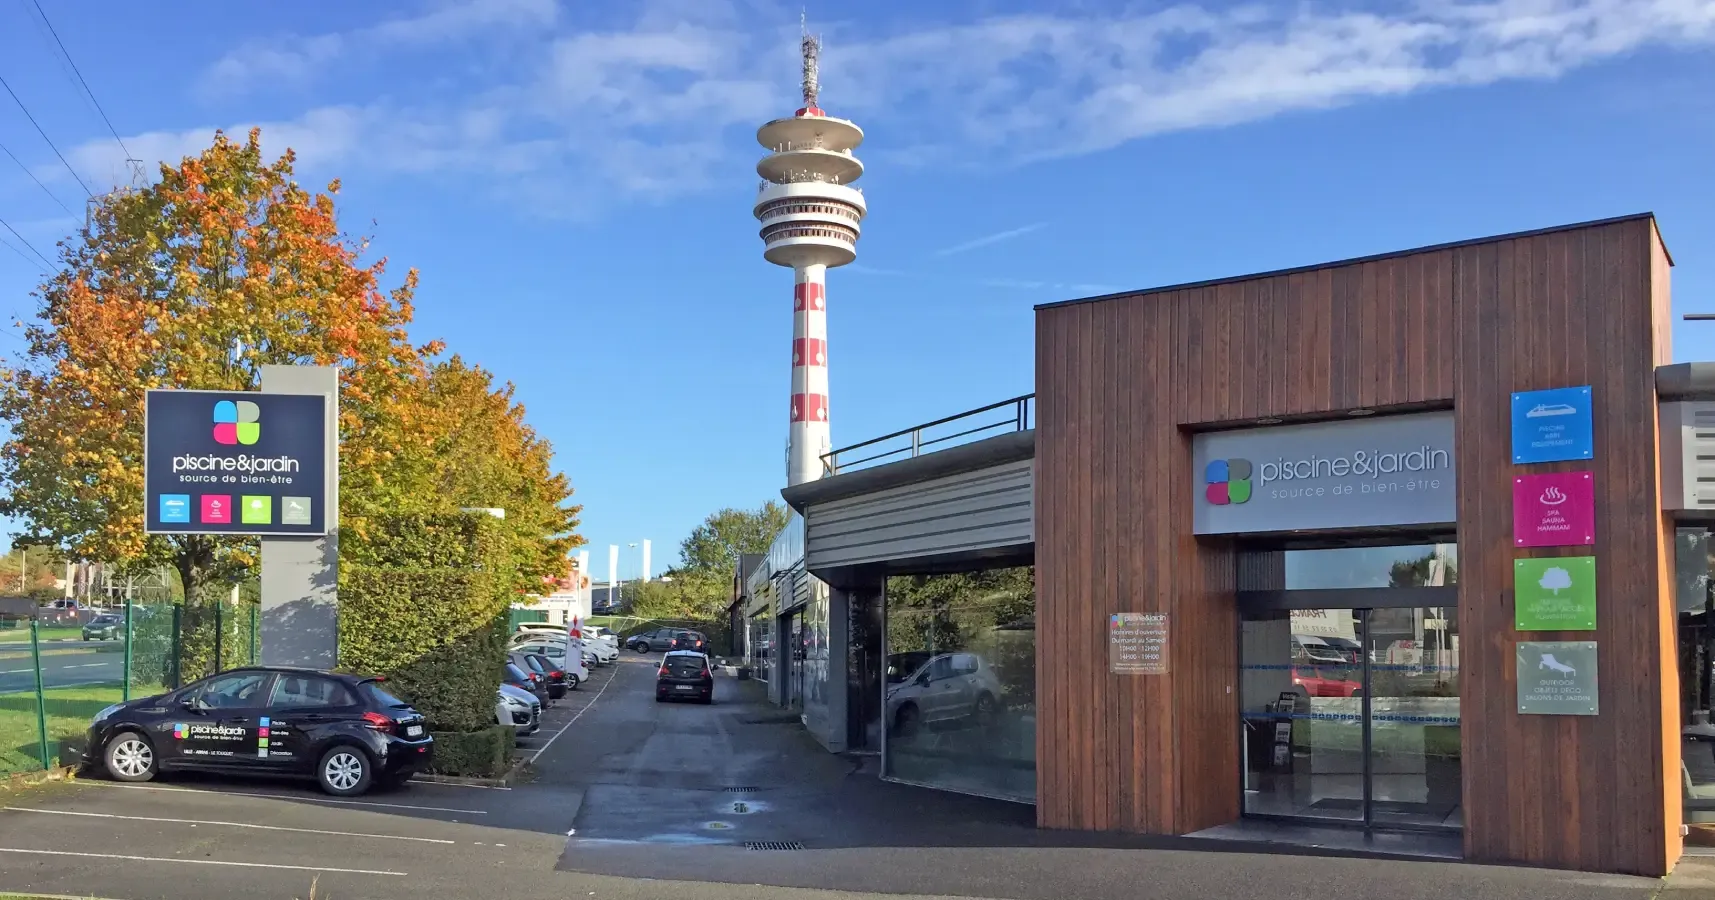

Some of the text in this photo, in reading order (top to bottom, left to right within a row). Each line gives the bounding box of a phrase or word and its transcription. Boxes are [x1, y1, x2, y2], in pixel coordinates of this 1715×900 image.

[173, 453, 299, 474] piscine&jardin
[1260, 445, 1449, 487] piscine&jardin
[179, 474, 293, 484] source de bien-être
[1271, 477, 1441, 500] source de bien-être
[1541, 516, 1566, 524] SAUNA
[1537, 523, 1571, 531] HAMMAM
[190, 725, 246, 736] piscine&jardin
